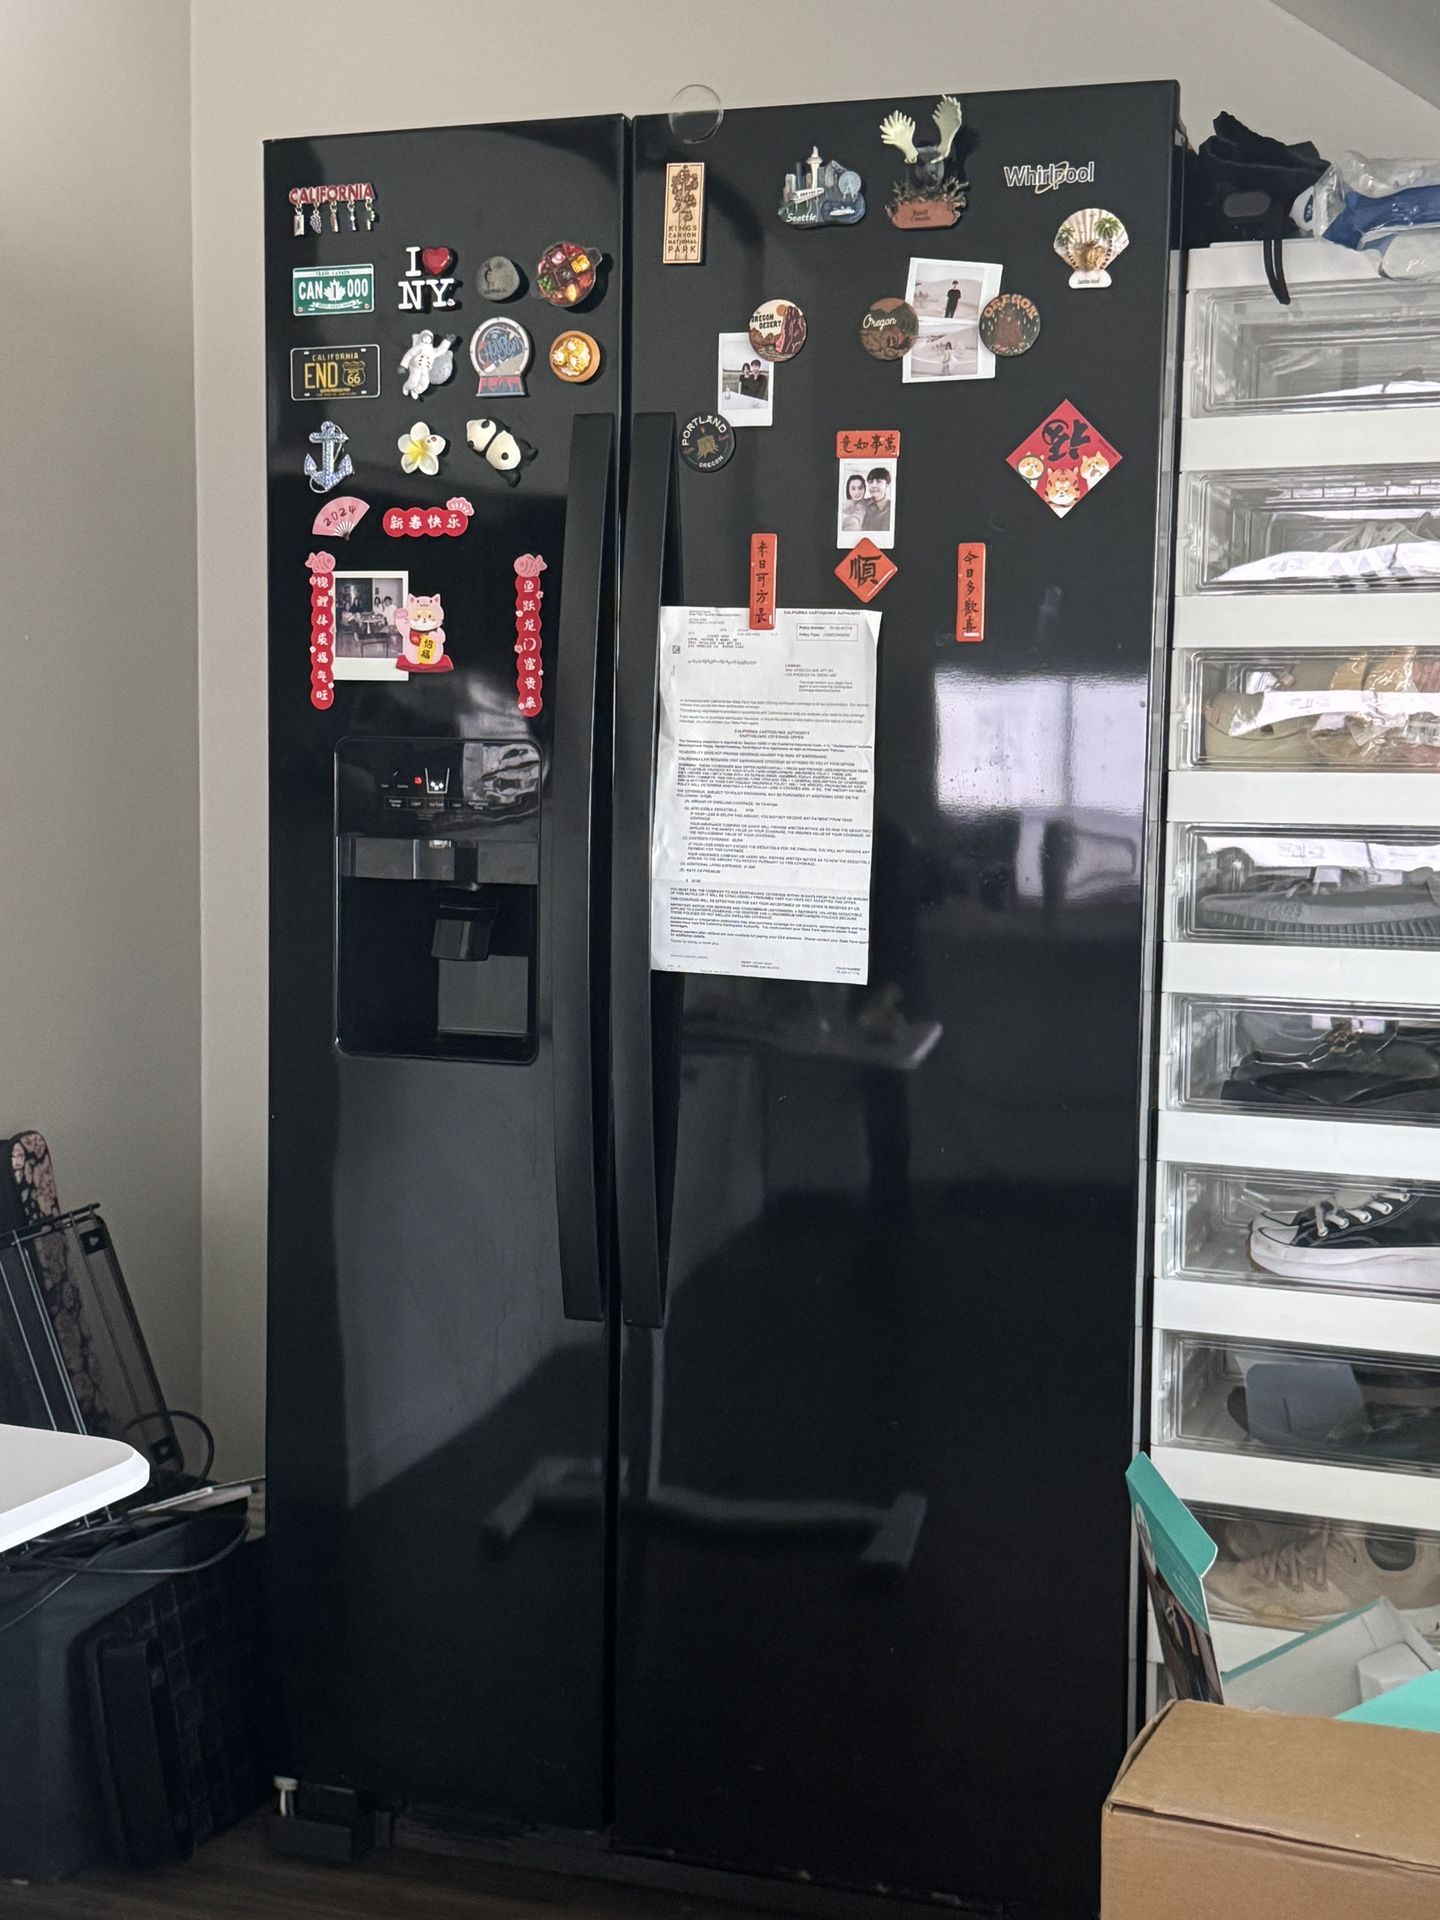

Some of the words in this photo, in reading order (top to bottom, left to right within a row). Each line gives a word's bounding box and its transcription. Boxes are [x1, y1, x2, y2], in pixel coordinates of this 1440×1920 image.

[1004, 161, 1095, 190] Whirlpool
[289, 183, 375, 206] CALIFORNIA
[786, 213, 816, 223] Seattle
[405, 246, 422, 277] I
[298, 280, 324, 300] CAN
[346, 278, 368, 297] 000
[984, 293, 1038, 319] OREGON
[751, 314, 774, 323] OREGON
[759, 320, 781, 329] DESERT
[862, 314, 897, 331] Oregon
[312, 352, 359, 361] CALIFORNIA
[304, 361, 338, 389] END
[347, 373, 361, 384] 66
[682, 415, 727, 446] PORTLAND
[699, 455, 724, 469] OREGON
[323, 505, 357, 527] 2024
[390, 514, 461, 530] 新春快乐
[848, 554, 883, 588] 順
